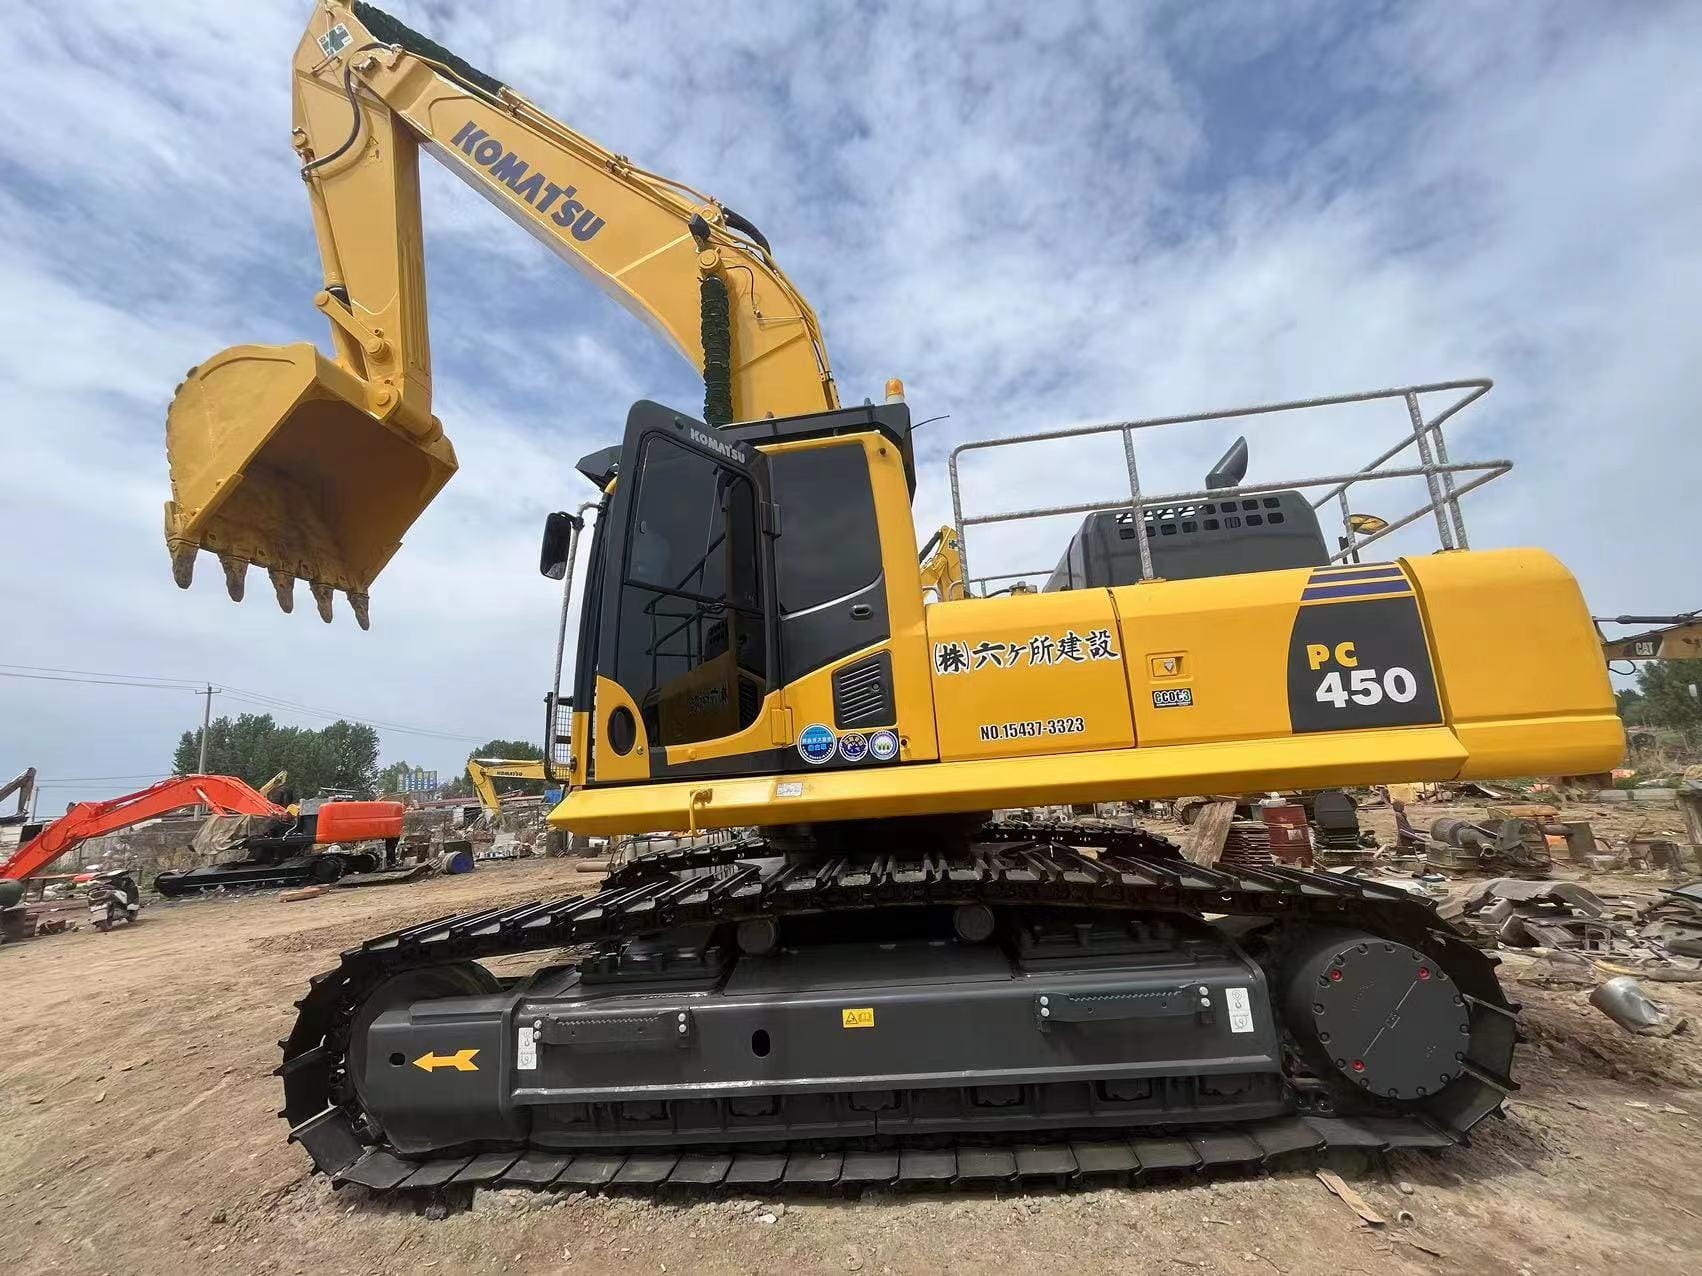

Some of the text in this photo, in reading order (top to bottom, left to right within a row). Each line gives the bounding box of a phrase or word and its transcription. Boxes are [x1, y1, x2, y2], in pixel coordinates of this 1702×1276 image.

[450, 120, 607, 242] KOMATSU
[690, 428, 746, 464] KOMATSU
[1306, 641, 1358, 670] PC
[1635, 641, 1654, 656] CAT
[1154, 689, 1191, 704] ecot3
[1315, 666, 1417, 708] 450
[980, 717, 1085, 741] NO.15437-3323
